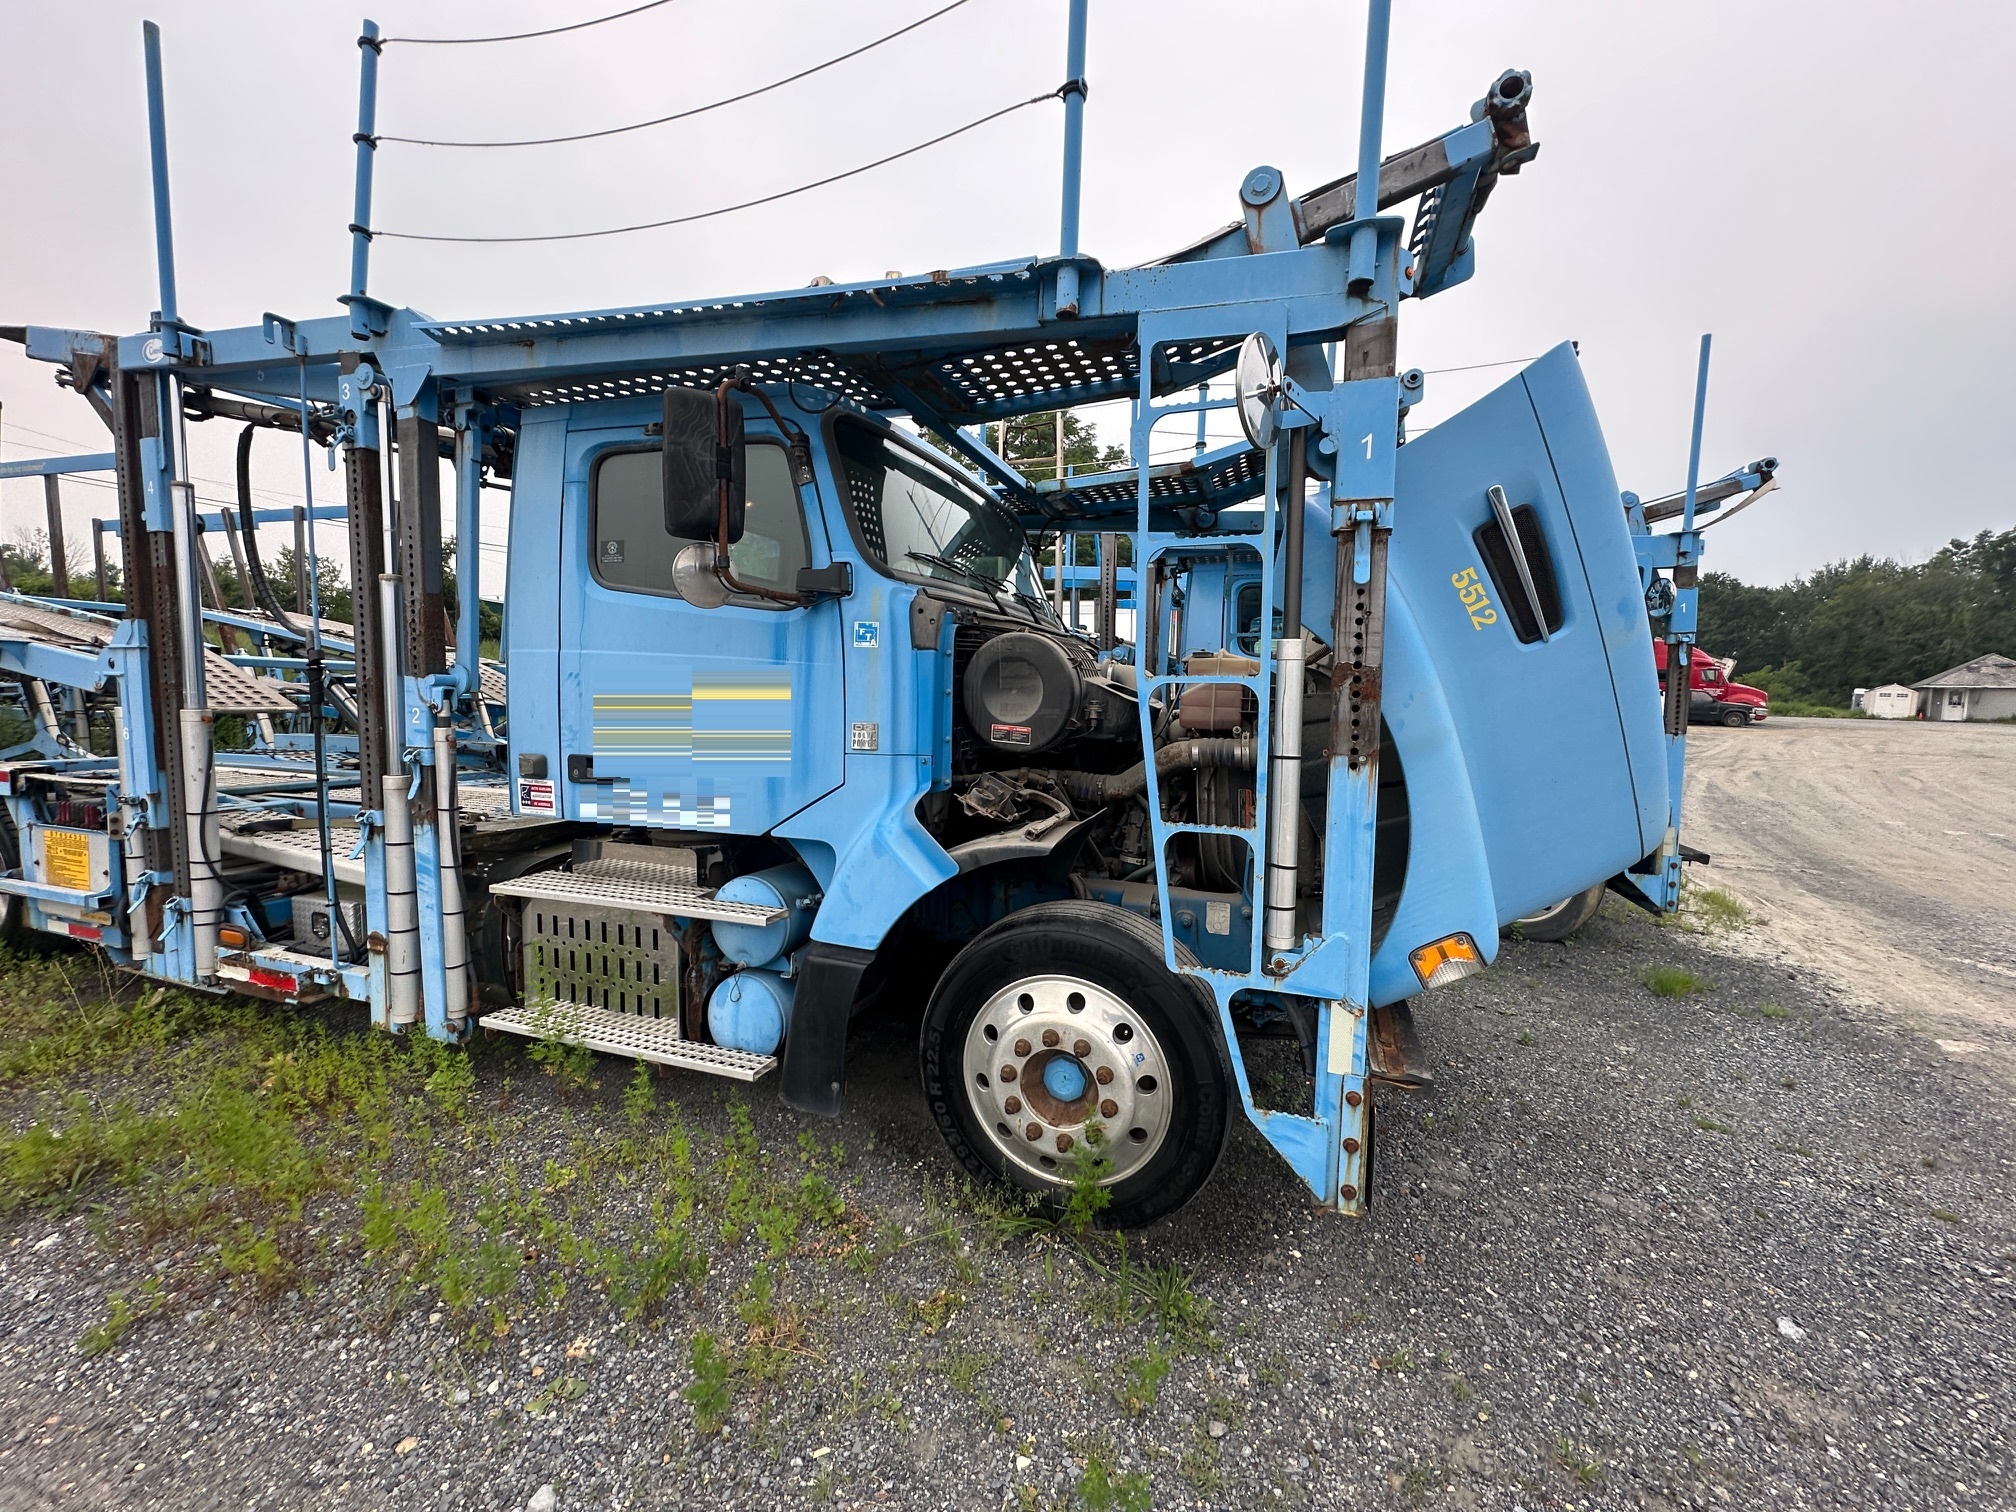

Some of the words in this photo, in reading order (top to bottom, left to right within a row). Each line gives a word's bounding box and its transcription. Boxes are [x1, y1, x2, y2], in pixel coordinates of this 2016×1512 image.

[342, 383, 350, 400] 3
[1361, 433, 1372, 459] 1
[147, 481, 154, 495] 4
[1451, 566, 1497, 631] 5512
[1680, 602, 1686, 613] 1
[411, 707, 420, 724] 2
[123, 727, 130, 740] 6
[852, 731, 877, 739] VOLVO
[852, 739, 877, 748] POWER
[926, 1031, 941, 1077] 22.5
[931, 1082, 943, 1096] R
[934, 1100, 979, 1170] 295/60
